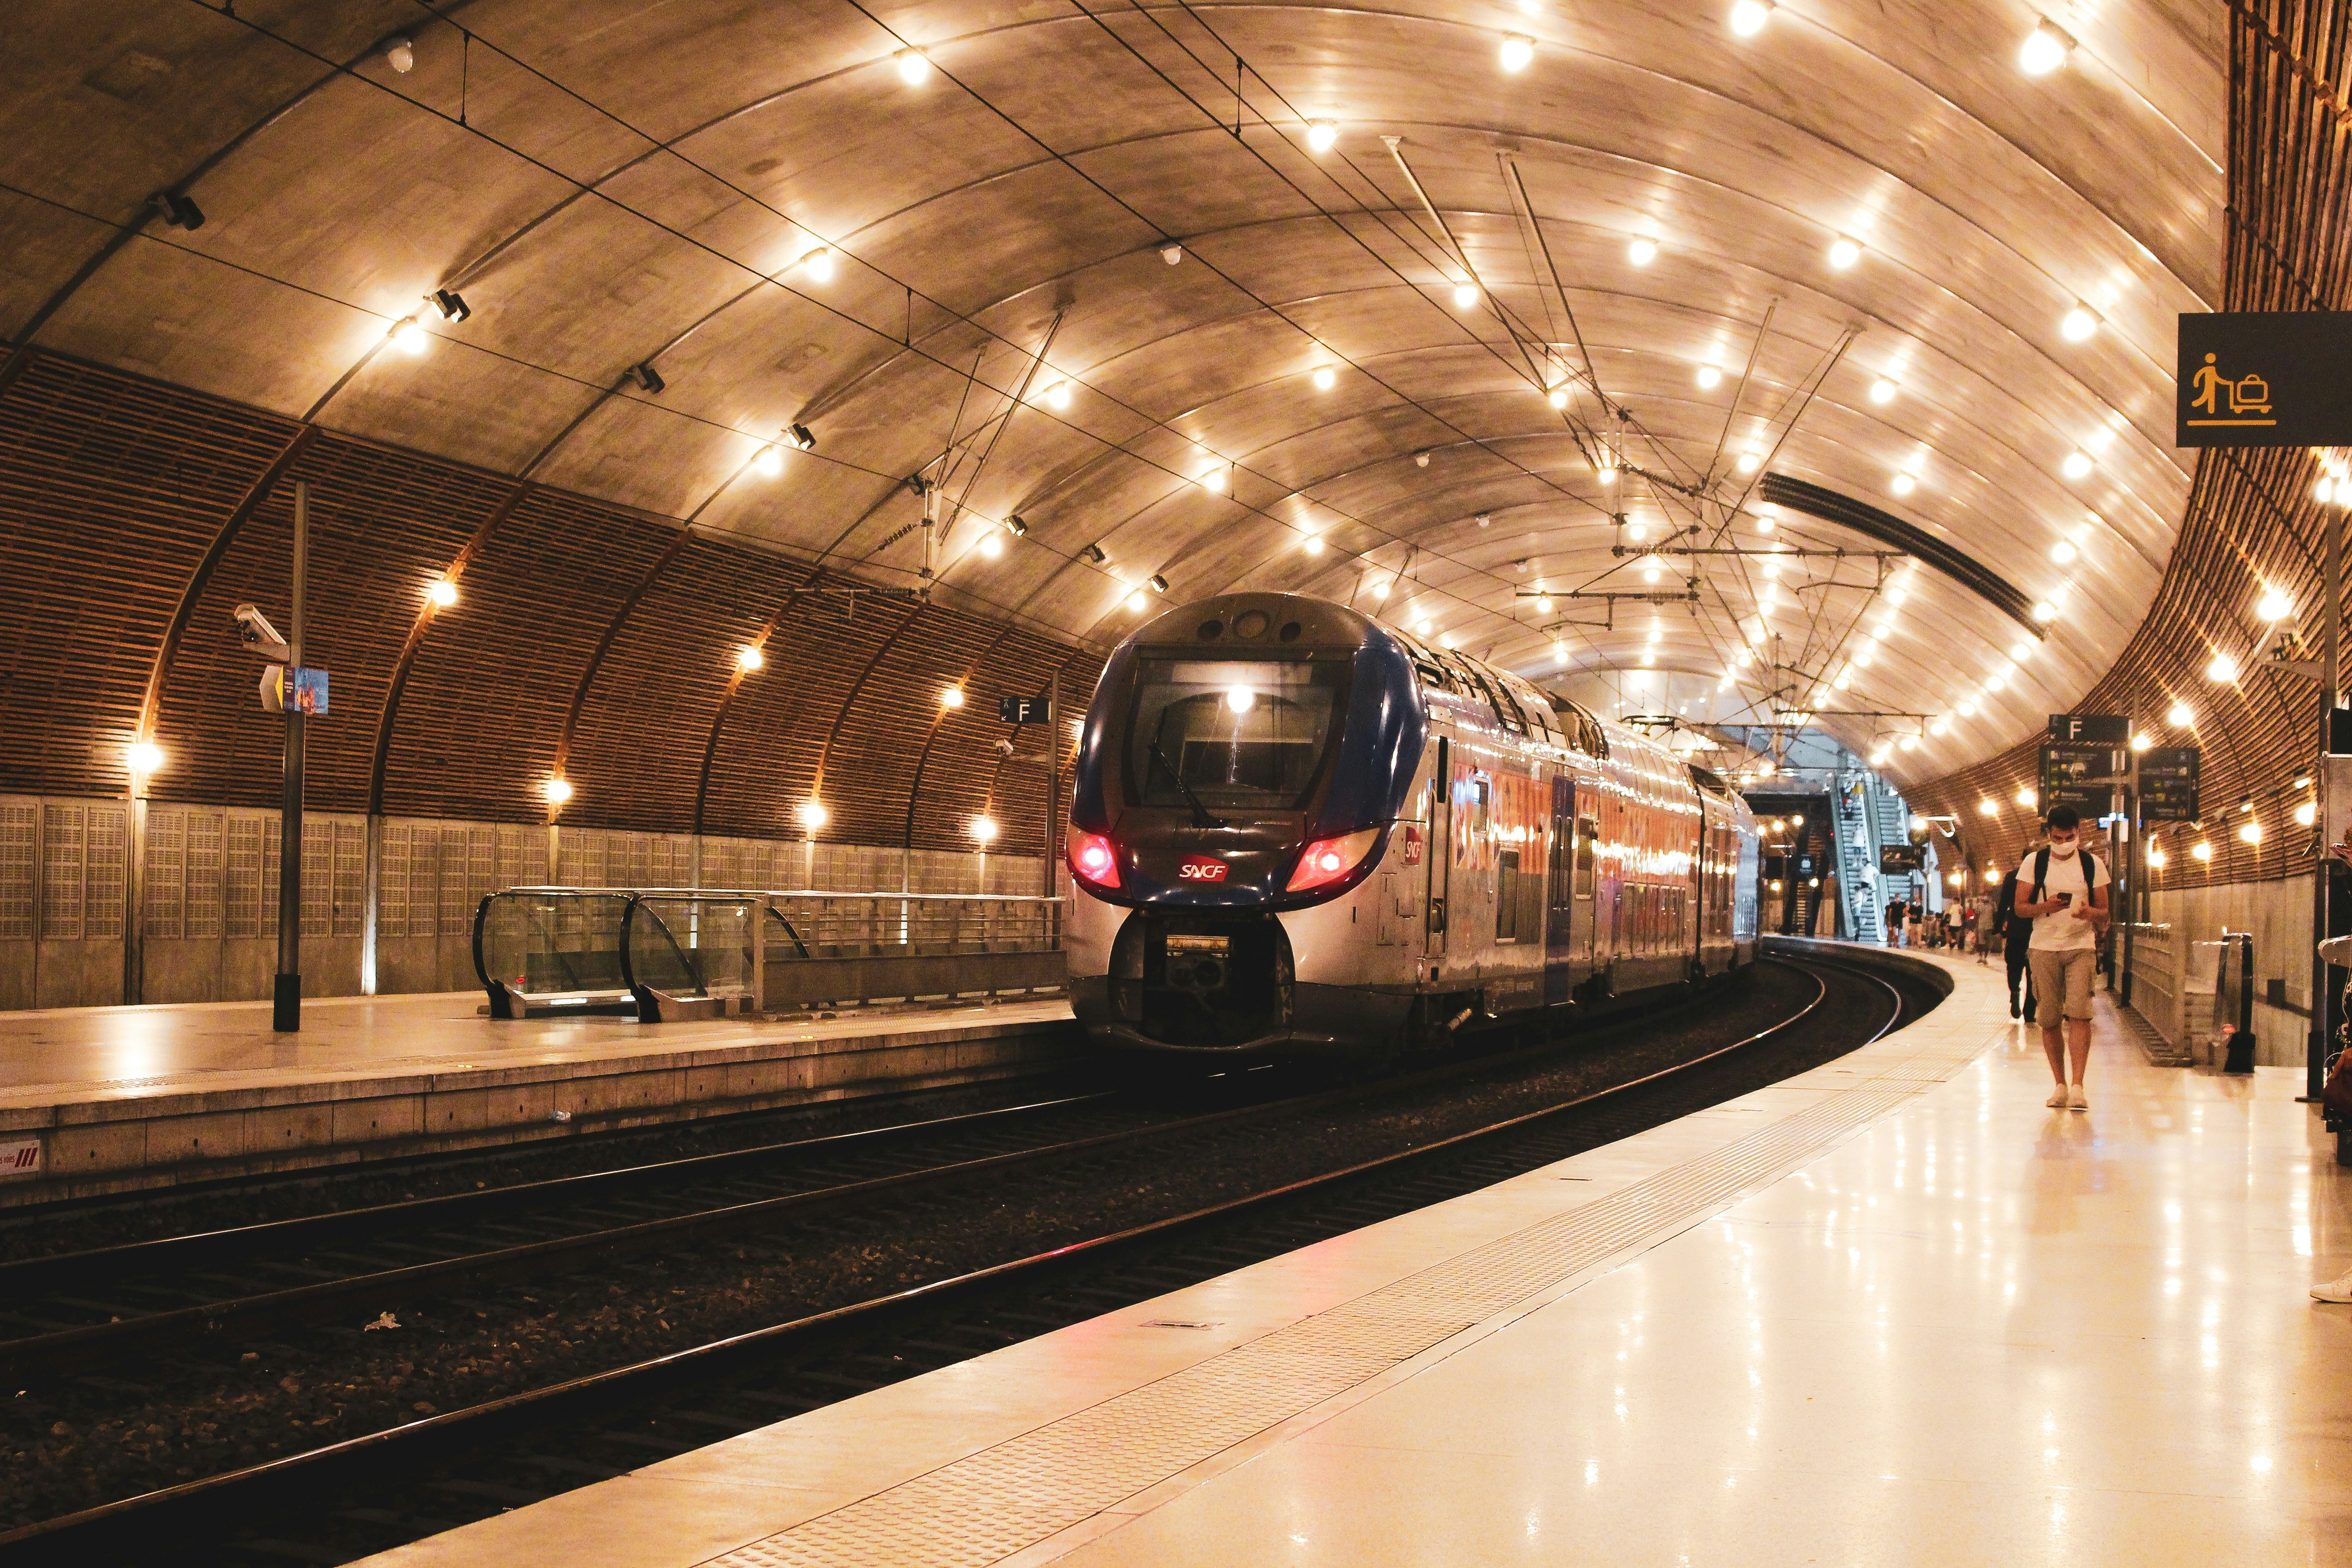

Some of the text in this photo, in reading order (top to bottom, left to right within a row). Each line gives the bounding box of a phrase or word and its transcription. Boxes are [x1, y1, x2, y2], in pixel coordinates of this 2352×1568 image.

[1019, 704, 1030, 721] F
[2070, 720, 2082, 740] F
[1406, 841, 1421, 858] SNCF
[1179, 864, 1226, 878] SNCF
